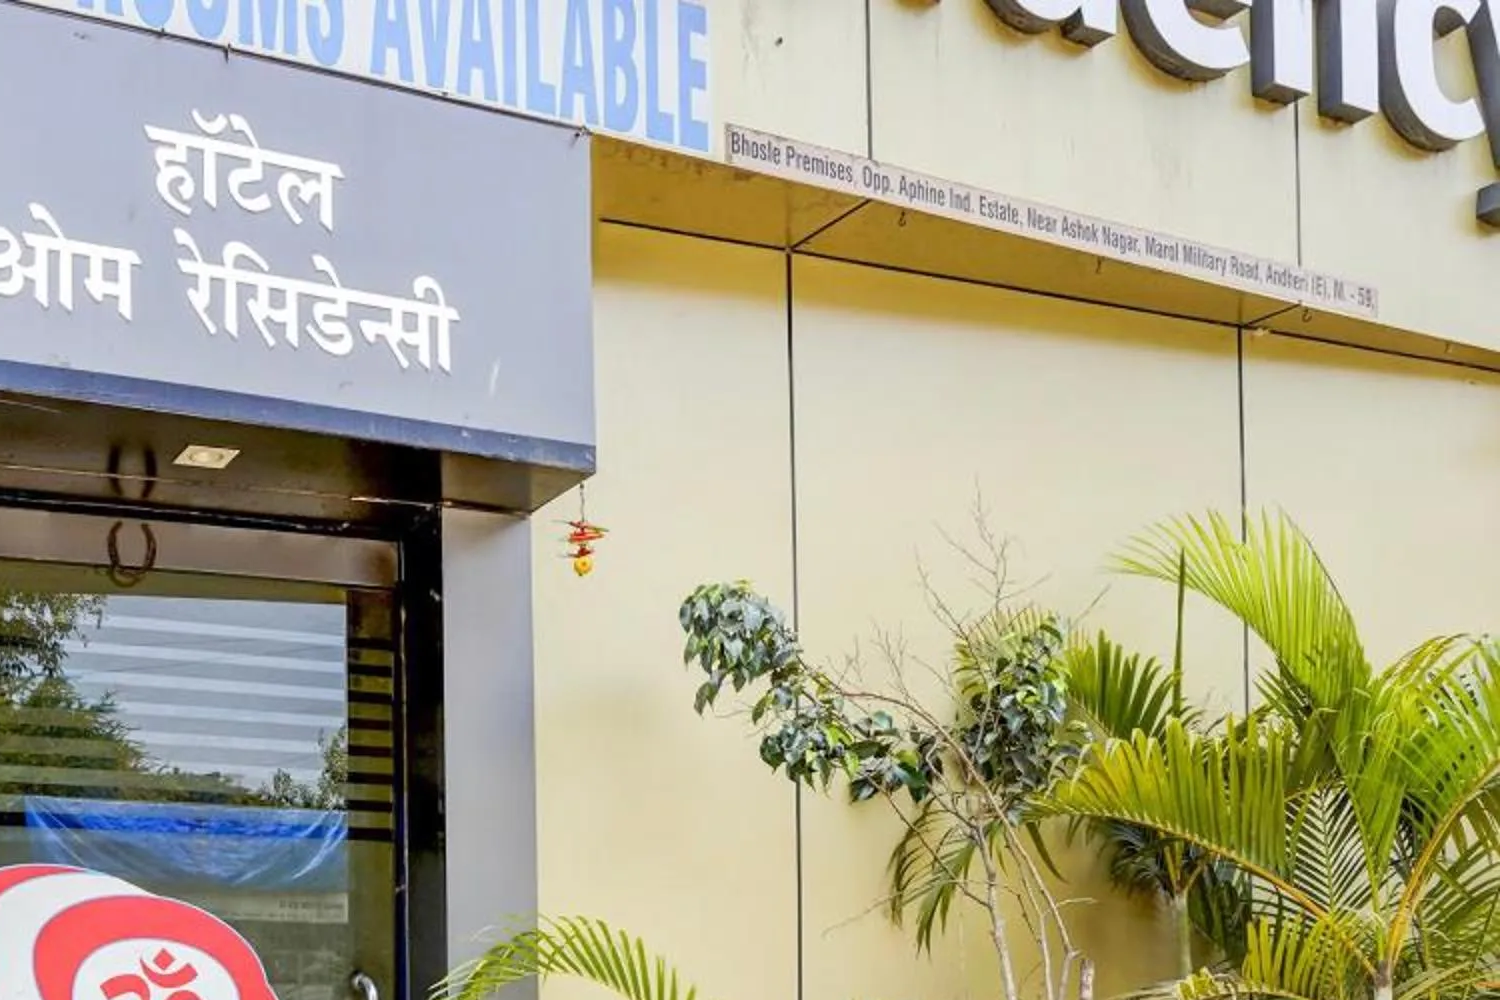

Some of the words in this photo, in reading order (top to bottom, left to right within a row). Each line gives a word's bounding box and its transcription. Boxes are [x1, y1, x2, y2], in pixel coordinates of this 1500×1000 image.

[370, 0, 709, 152] AVAILABLE
[143, 108, 346, 232] हॉटेल
[731, 131, 781, 165] Bhosle
[862, 165, 894, 195] Opp.
[899, 175, 946, 206] Aphine
[949, 187, 975, 213] Ind.
[979, 195, 1024, 227] Estate,
[1027, 207, 1058, 233] Near
[1061, 215, 1099, 243] Ashok
[1102, 226, 1141, 256] Nagar,
[1145, 235, 1179, 262] Marol
[1182, 244, 1227, 277] Military
[1230, 255, 1263, 284] Road,
[173, 227, 460, 375] रेसिडेन्सी
